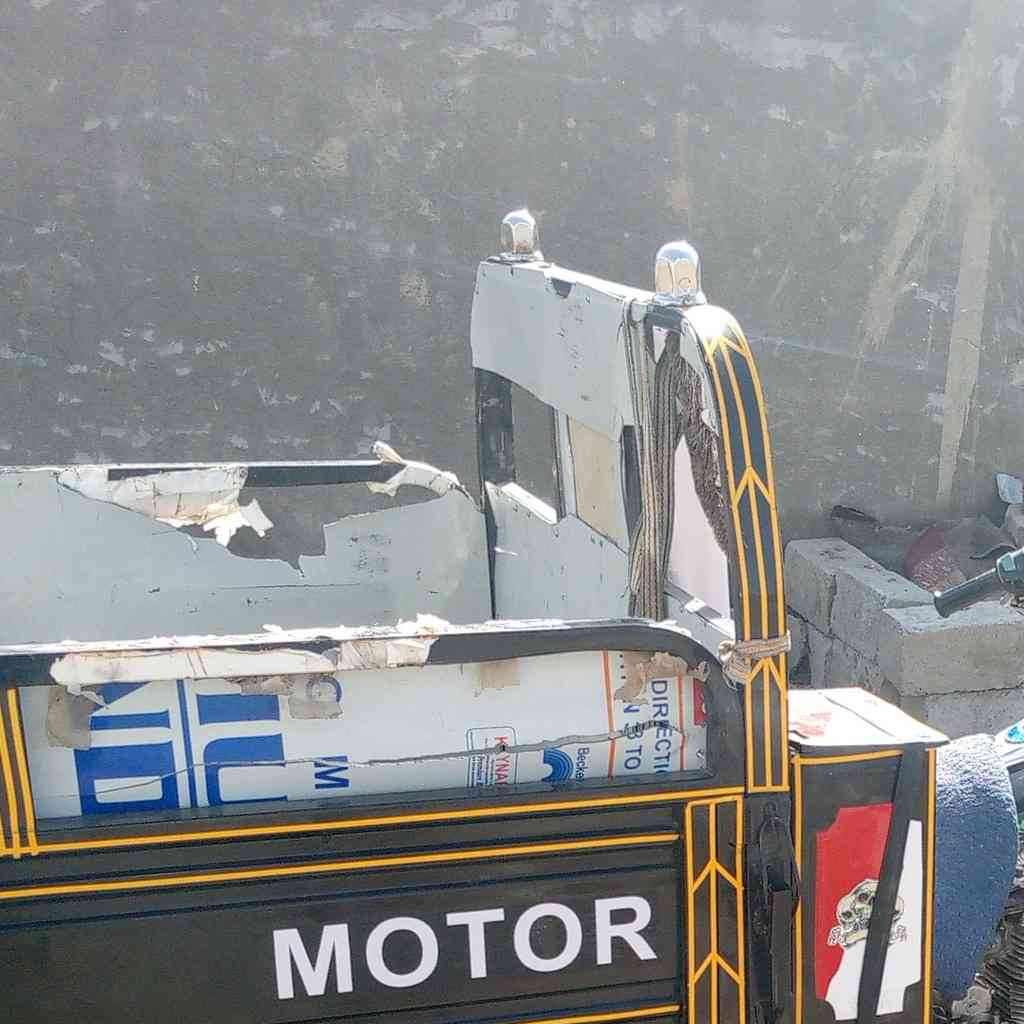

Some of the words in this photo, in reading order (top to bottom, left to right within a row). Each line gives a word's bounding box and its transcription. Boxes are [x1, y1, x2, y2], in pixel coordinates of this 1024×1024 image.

[624, 745, 643, 770] TO
[651, 680, 674, 773] DIRECTI
[272, 895, 658, 999] MOTOR
